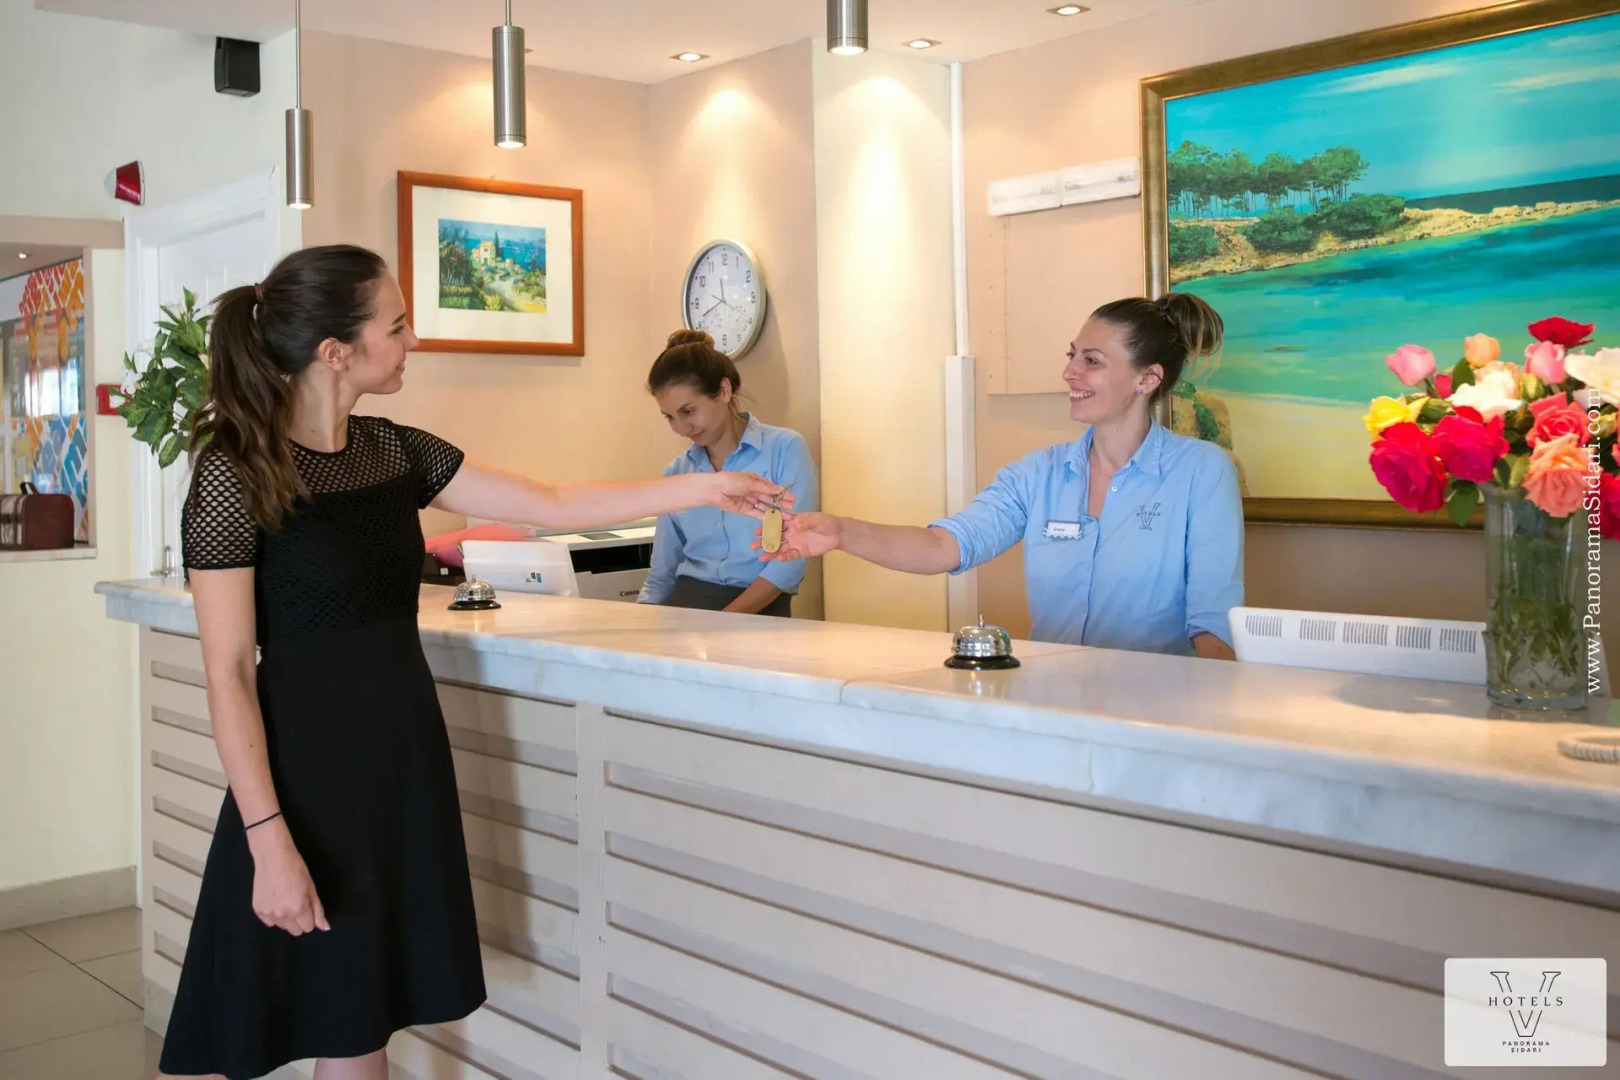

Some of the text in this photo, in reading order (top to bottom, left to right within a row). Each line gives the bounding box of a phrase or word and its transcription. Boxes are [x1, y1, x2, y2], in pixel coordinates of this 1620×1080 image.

[721, 253, 728, 266] 12
[708, 260, 714, 274] 11
[700, 275, 706, 288] 10
[746, 270, 752, 283] 2
[694, 297, 700, 310] 9
[750, 292, 756, 304] 3
[722, 334, 727, 346] 6
